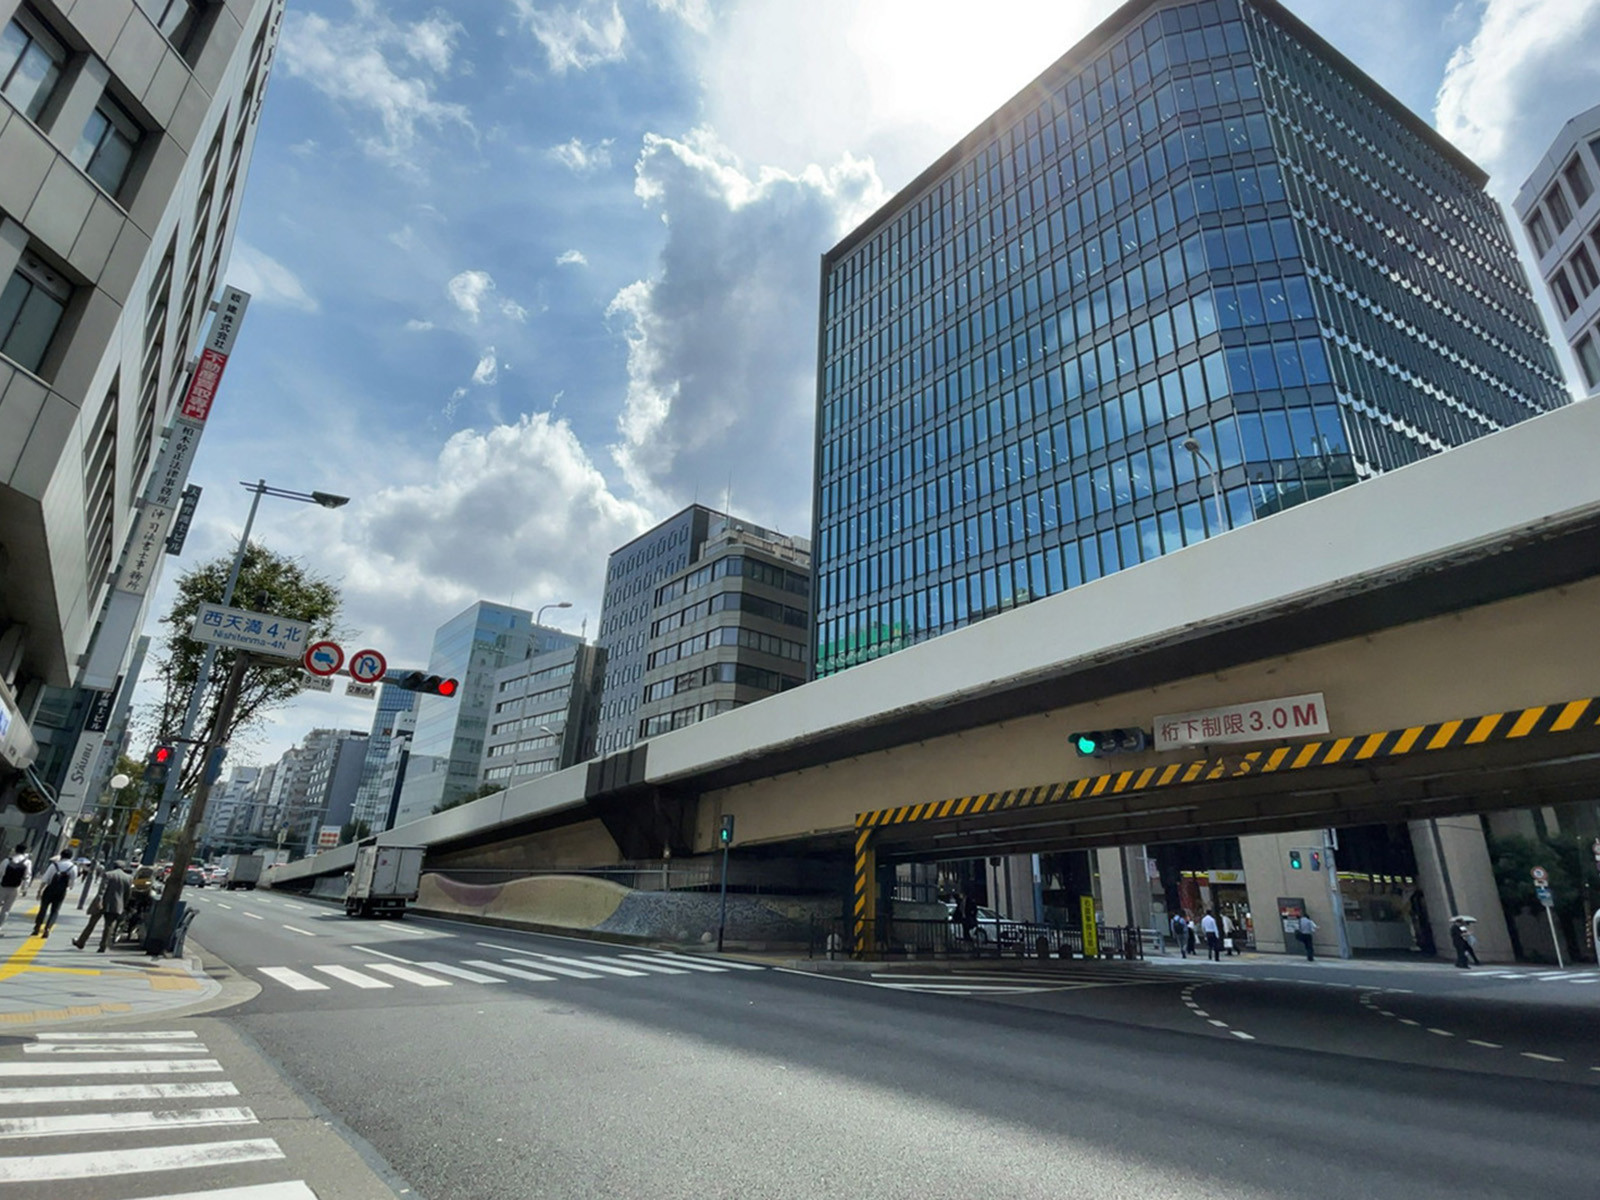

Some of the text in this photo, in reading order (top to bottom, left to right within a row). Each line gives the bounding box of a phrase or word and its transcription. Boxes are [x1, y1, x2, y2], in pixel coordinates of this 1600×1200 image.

[203, 610, 301, 642] 西天満4北
[213, 629, 287, 650] Nishitenma-4N
[1161, 703, 1318, 742] 桁下制限3.0M
